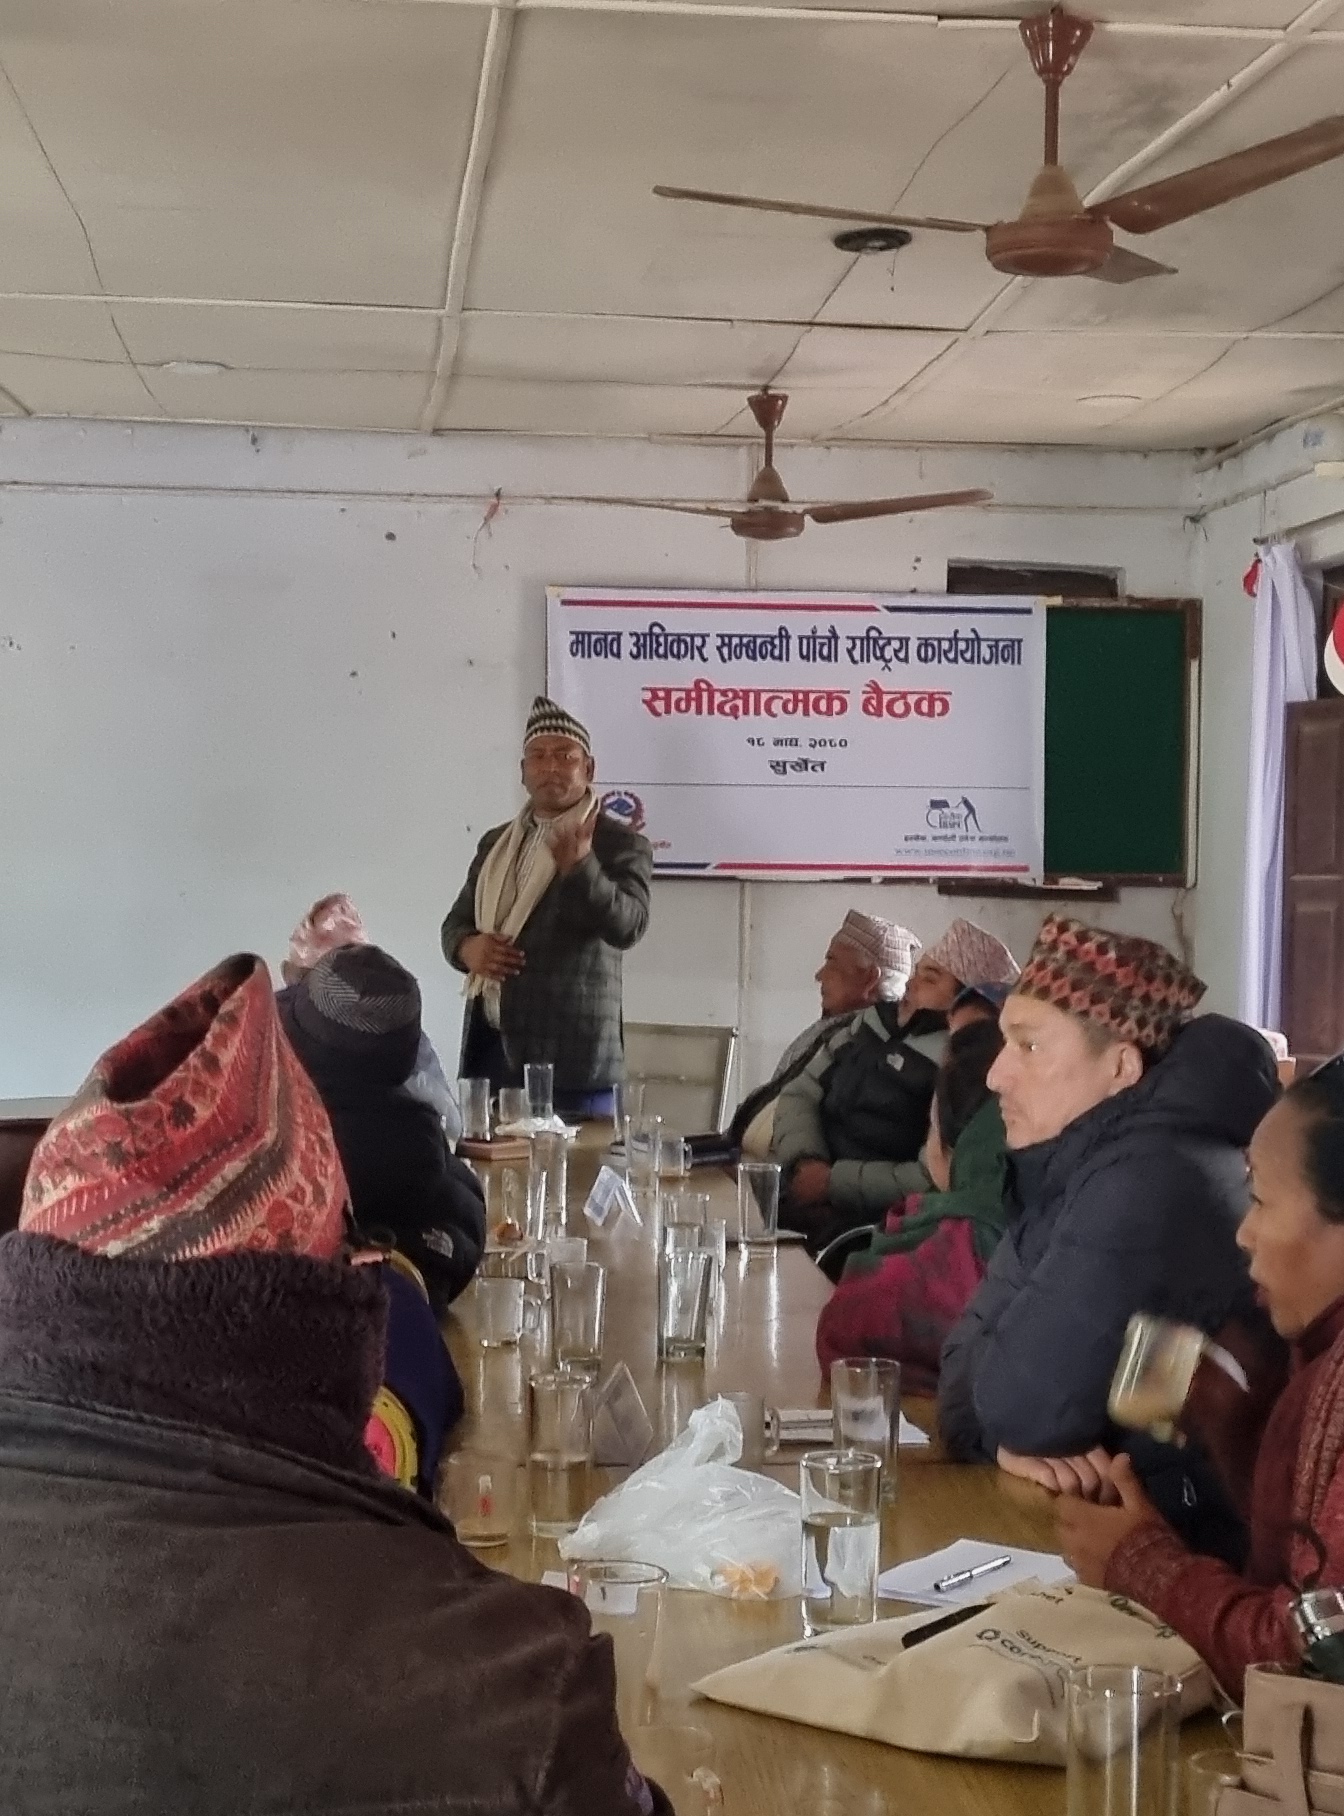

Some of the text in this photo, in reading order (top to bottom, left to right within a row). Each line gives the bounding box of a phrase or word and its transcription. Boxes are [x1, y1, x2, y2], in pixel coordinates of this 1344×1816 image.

[568, 630, 623, 660] मानव
[628, 621, 710, 662] अधिकार
[715, 625, 791, 663] सम्बन्धी
[845, 625, 911, 672] राष्ट्रिय
[916, 628, 1024, 665] कार्ययोजना
[641, 678, 953, 720] समीक्षात्मक बैठक
